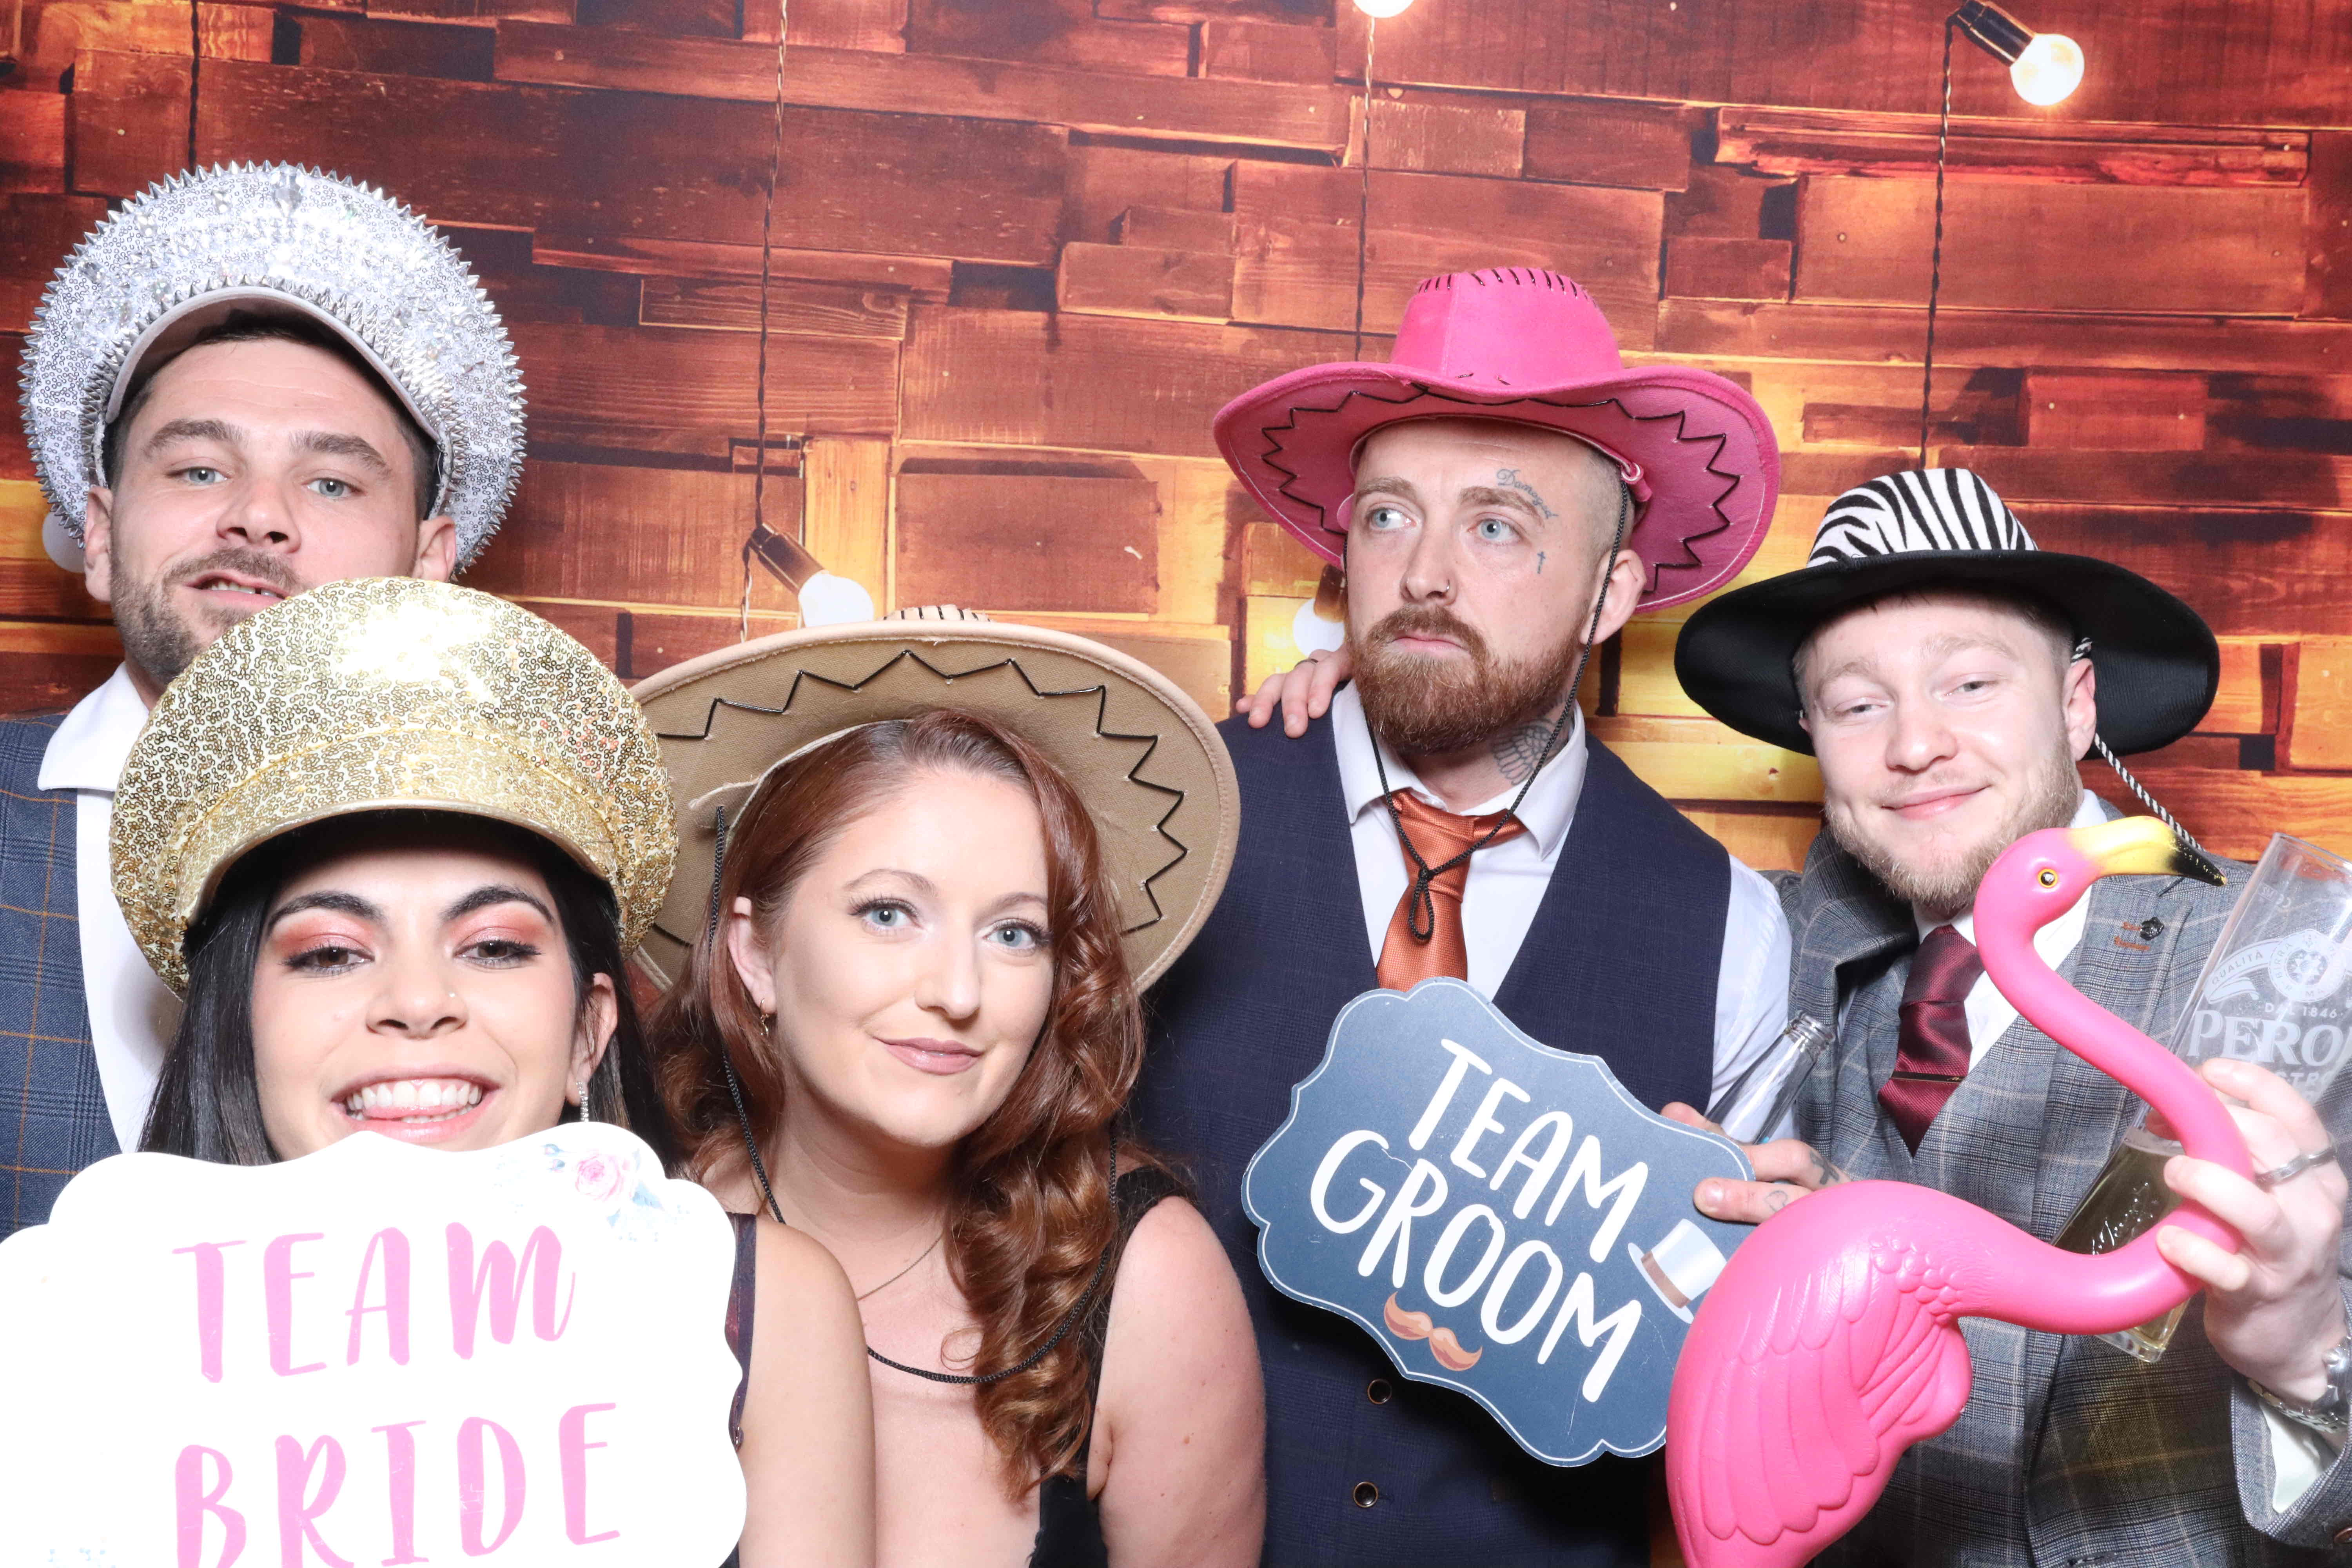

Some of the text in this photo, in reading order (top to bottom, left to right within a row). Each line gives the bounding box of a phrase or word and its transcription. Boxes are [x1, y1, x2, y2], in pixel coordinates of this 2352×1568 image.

[2186, 1009, 2352, 1067] PERO
[1408, 1038, 1648, 1263] TEAM
[172, 1222, 575, 1383] TEAM
[1310, 1130, 1642, 1403] GROOM
[175, 1403, 620, 1568] BRIDE
